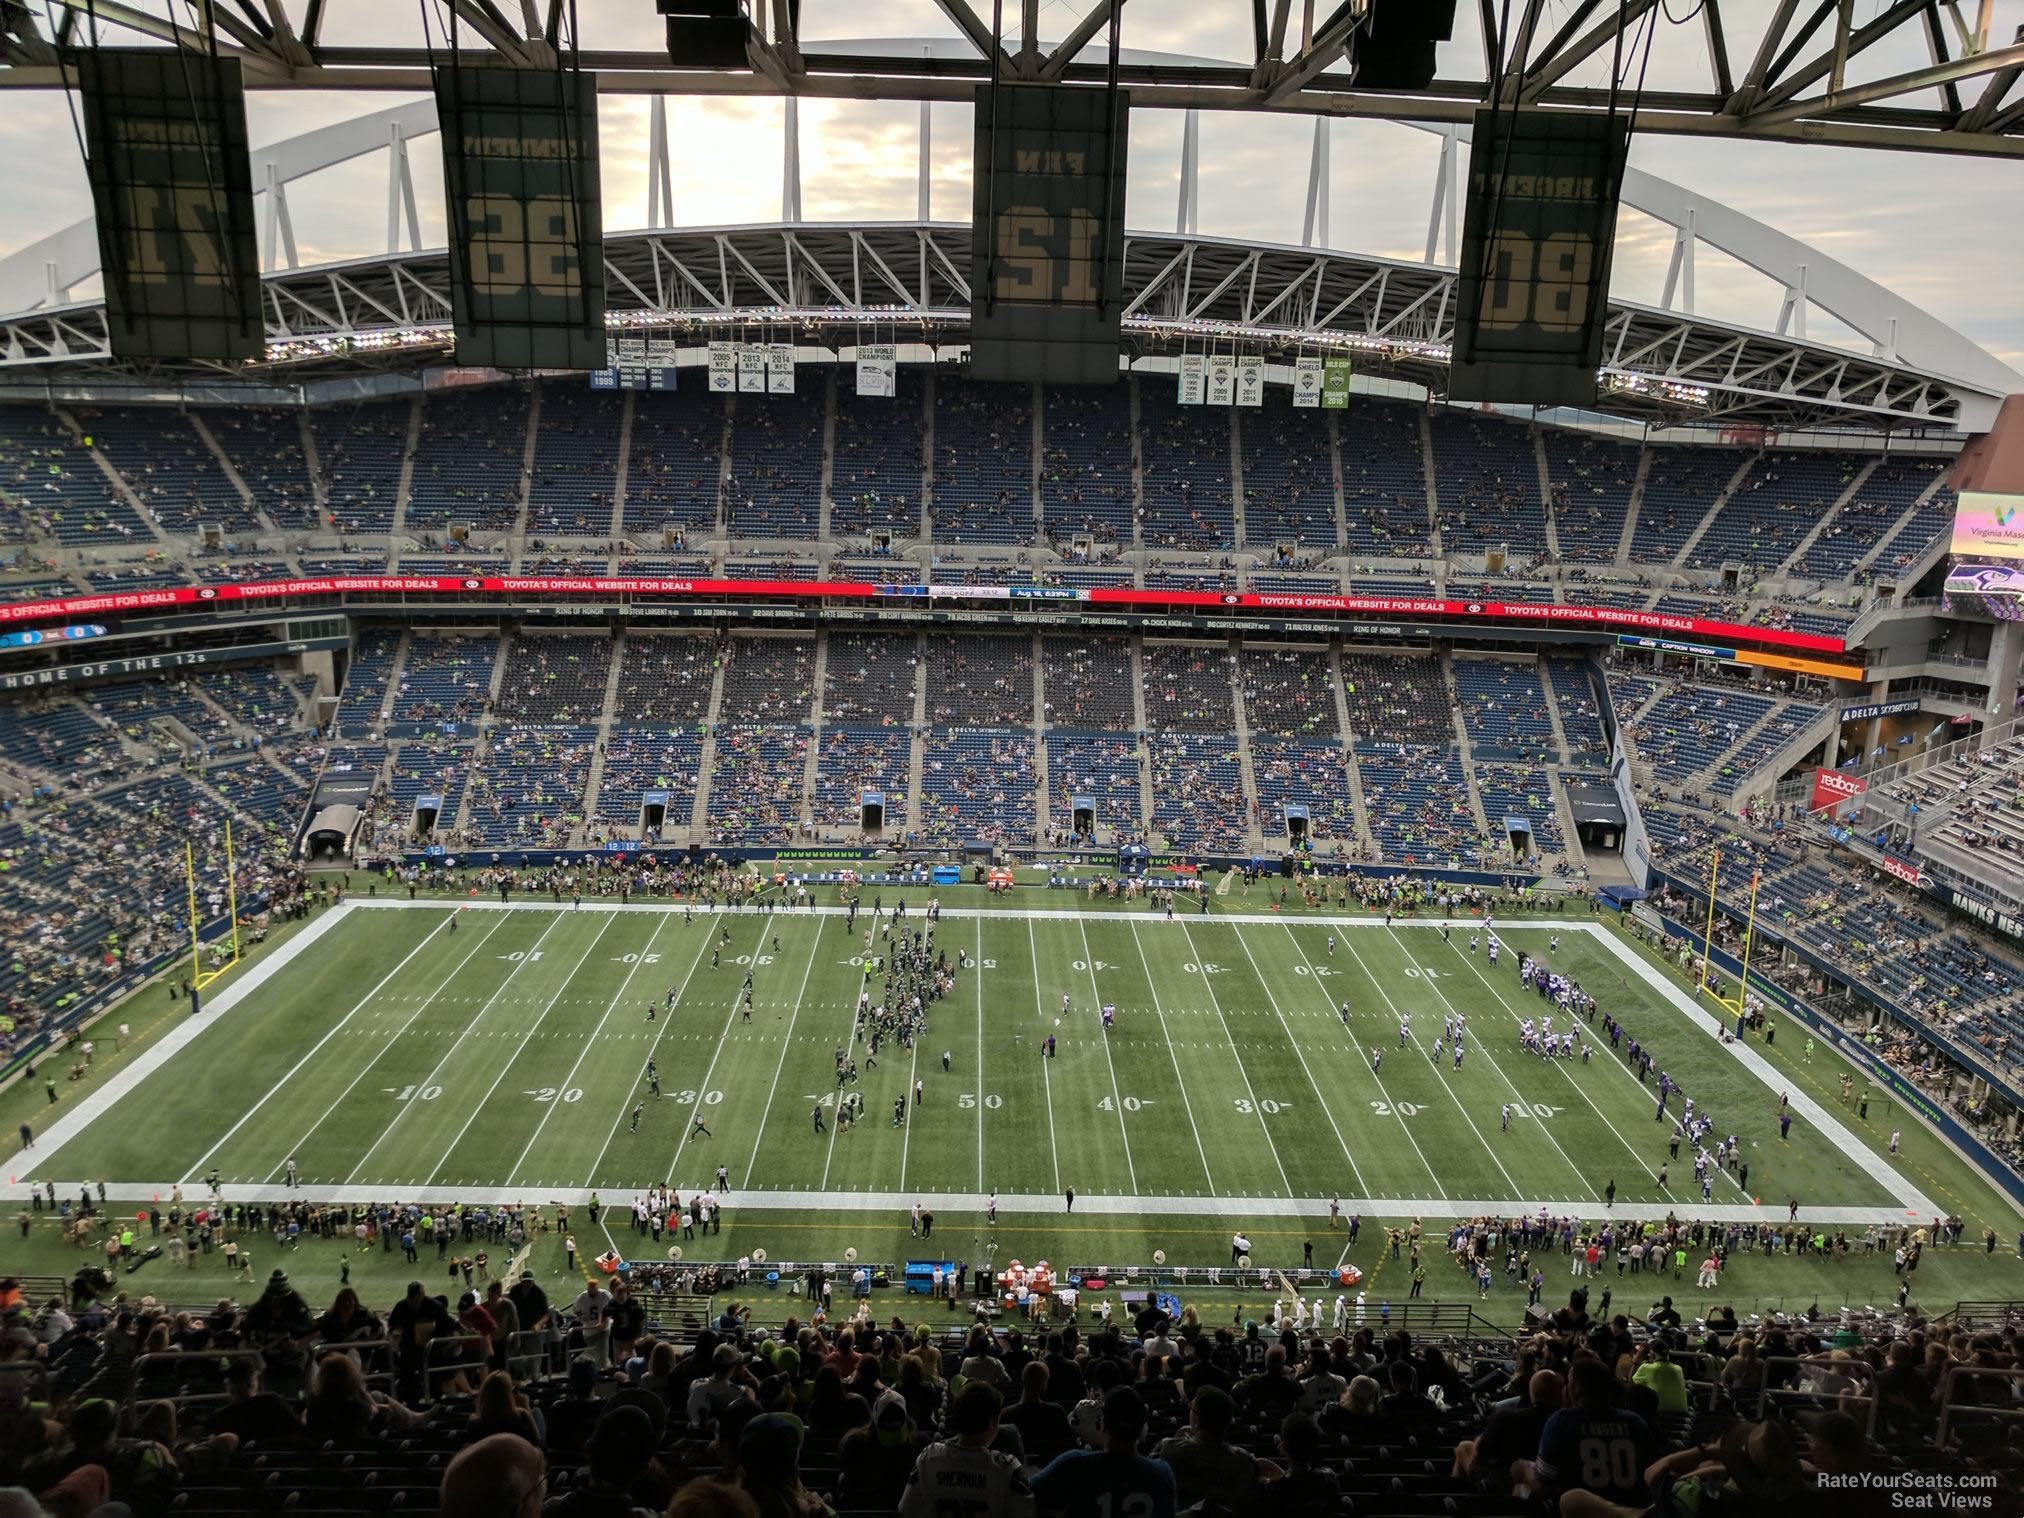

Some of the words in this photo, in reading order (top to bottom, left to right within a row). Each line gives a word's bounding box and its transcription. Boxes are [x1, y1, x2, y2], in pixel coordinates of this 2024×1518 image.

[713, 353, 731, 361] 2005
[742, 355, 760, 363] 2013
[595, 377, 613, 386] 1999
[1971, 527, 2002, 538] Virginia
[240, 584, 287, 596] TOYOTA'S
[289, 581, 333, 592] OFFICIAL
[335, 580, 379, 589] WEBSITE
[382, 580, 403, 588] FOR
[405, 580, 438, 589] DEALS
[503, 580, 548, 589] TOYOTA'S
[550, 580, 593, 589] OFFICIAL
[594, 581, 638, 589] WEBSITE
[640, 582, 660, 590] FOR
[661, 582, 692, 591] DEALS
[1016, 590, 1032, 598] Aug.
[1033, 590, 1043, 598] 18,
[12, 603, 64, 617] OFFICIAL
[66, 598, 114, 611] WEBSITE
[115, 596, 139, 606] FOR
[143, 593, 176, 603] DEALS
[1259, 596, 1303, 606] TOYOTA'S
[1305, 597, 1346, 607] OFFICIAL
[1348, 599, 1390, 609] WEBSITE
[1392, 601, 1412, 610] FOR
[1414, 601, 1445, 611] DEALS
[1504, 605, 1549, 616] TOYOTA'S
[1551, 608, 1594, 618] OFFICIAL
[1597, 610, 1638, 623] WEBSITE
[1640, 615, 1660, 625] FOR
[1662, 618, 1693, 629] DEALS
[1380, 626, 1401, 634] HONOR
[1661, 642, 1688, 652] CAPTION
[1689, 645, 1715, 655] WINDOW
[6, 669, 68, 687] HOME
[82, 664, 109, 677] OF
[122, 657, 161, 672] THE
[1851, 707, 1878, 719] DELTA
[1952, 892, 1996, 924] HAWKS
[395, 1085, 443, 1101] 10
[534, 1088, 585, 1103] 20
[676, 1090, 724, 1105] 30
[957, 1094, 1003, 1109] 50
[1097, 1096, 1142, 1111] 40
[1234, 1099, 1281, 1114] 30
[1370, 1101, 1417, 1116] 20
[1510, 1103, 1554, 1118] 10
[1244, 1342, 1265, 1363] 12
[1577, 1438, 1638, 1488] 80
[935, 1471, 987, 1489] SHERMAN
